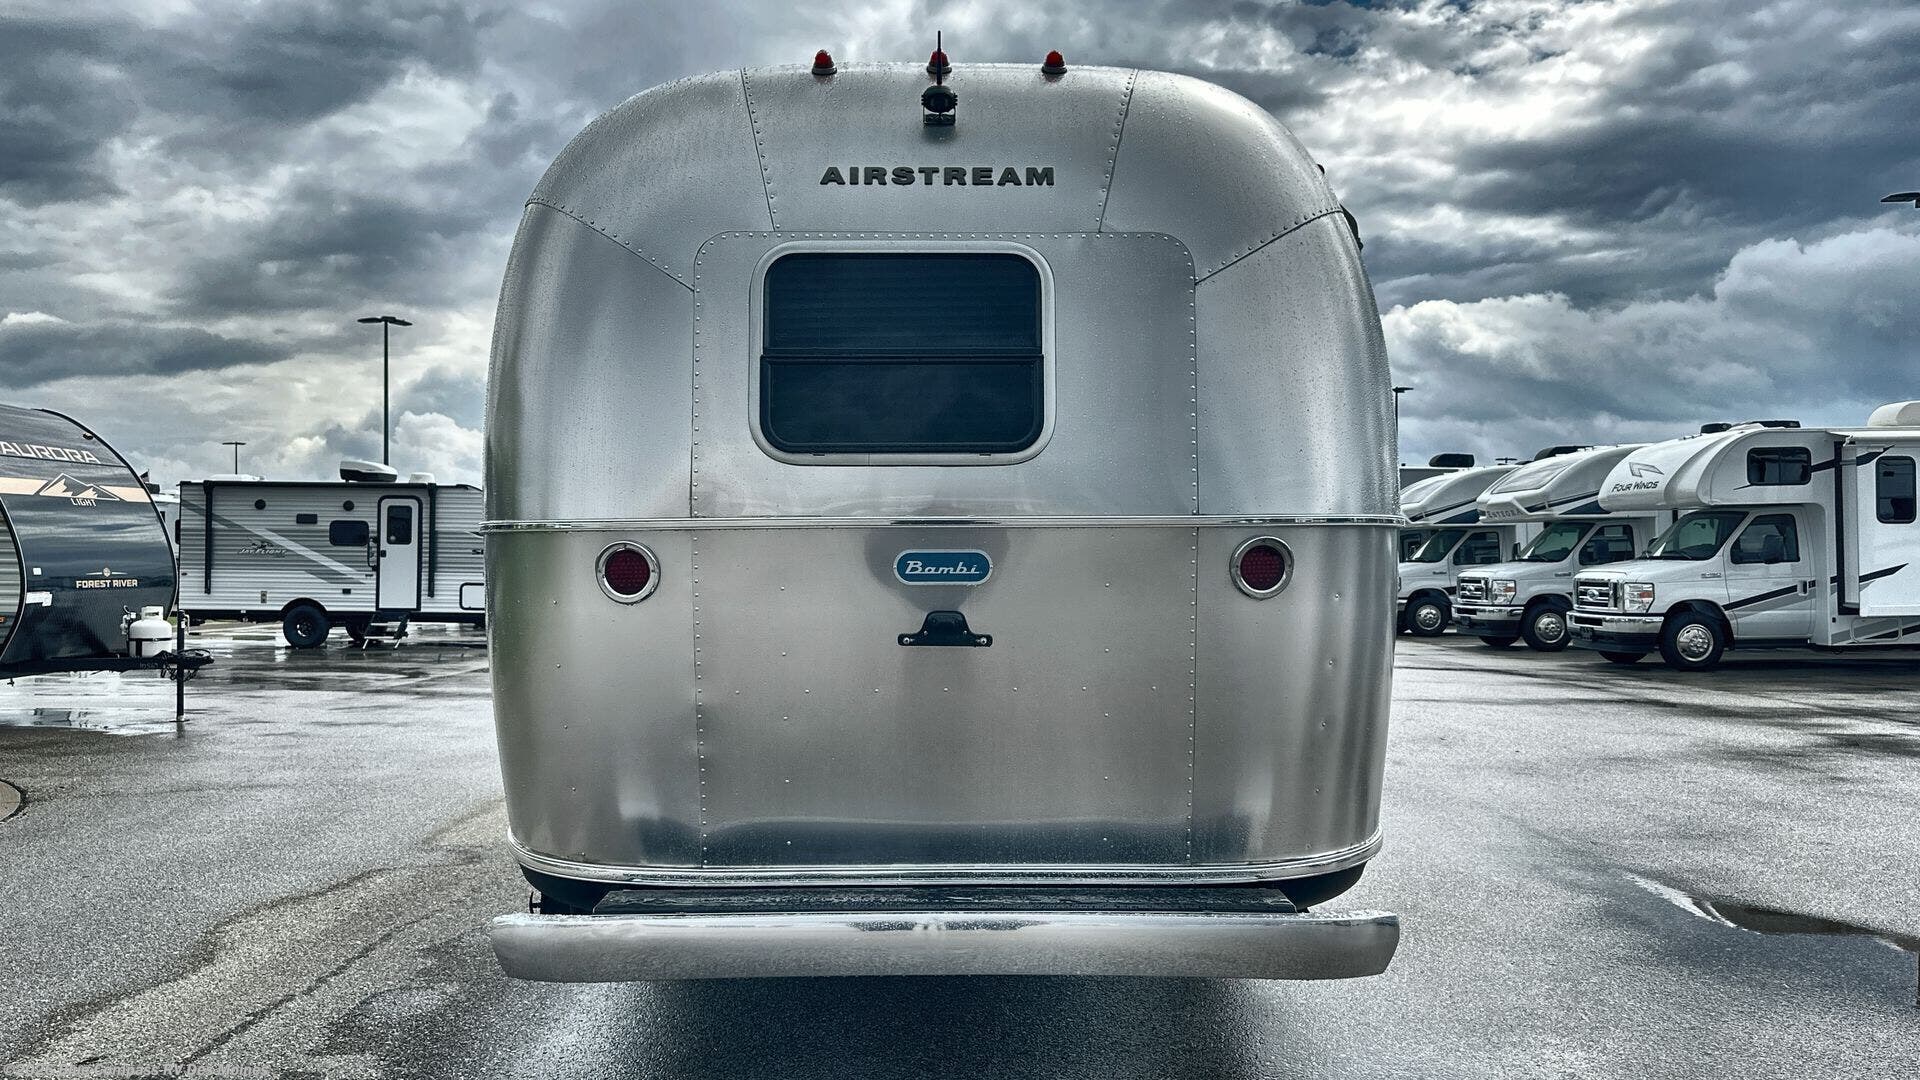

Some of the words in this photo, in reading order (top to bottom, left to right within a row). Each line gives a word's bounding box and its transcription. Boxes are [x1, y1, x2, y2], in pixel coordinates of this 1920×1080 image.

[820, 166, 1055, 186] AIRSTREAM
[0, 441, 101, 464] AURORA
[1611, 483, 1632, 492] FOUR
[1633, 481, 1659, 490] WINDS
[70, 498, 97, 507] LIGHT
[905, 560, 981, 575] Bambi
[76, 580, 111, 589] FOREST
[113, 579, 138, 588] RIVER
